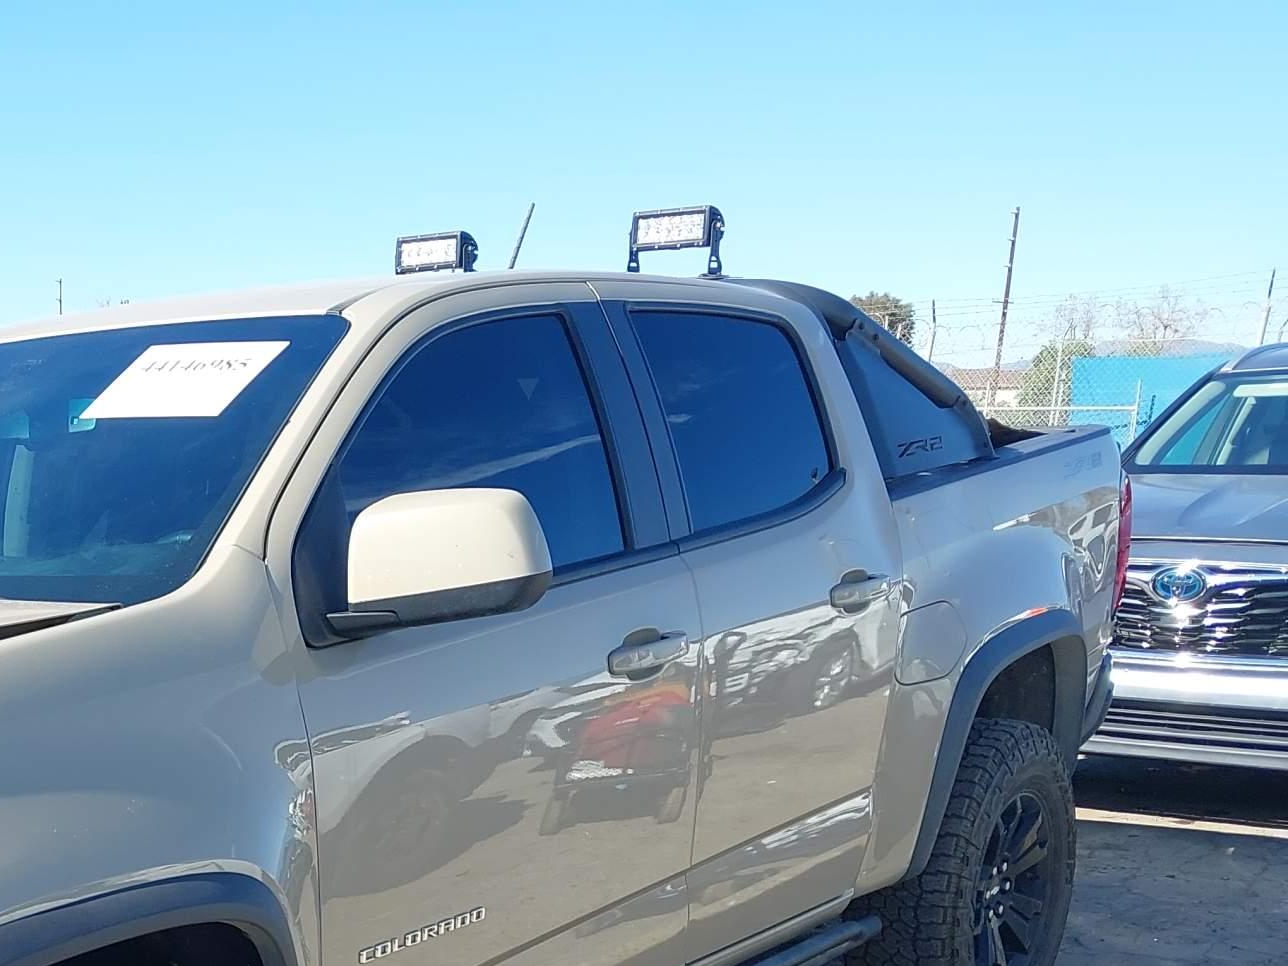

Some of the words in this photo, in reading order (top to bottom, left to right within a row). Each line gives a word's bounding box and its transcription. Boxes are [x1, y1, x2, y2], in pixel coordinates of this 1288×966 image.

[141, 357, 253, 373] 44146985
[896, 434, 944, 459] ZR2
[358, 906, 487, 964] COLORADO
